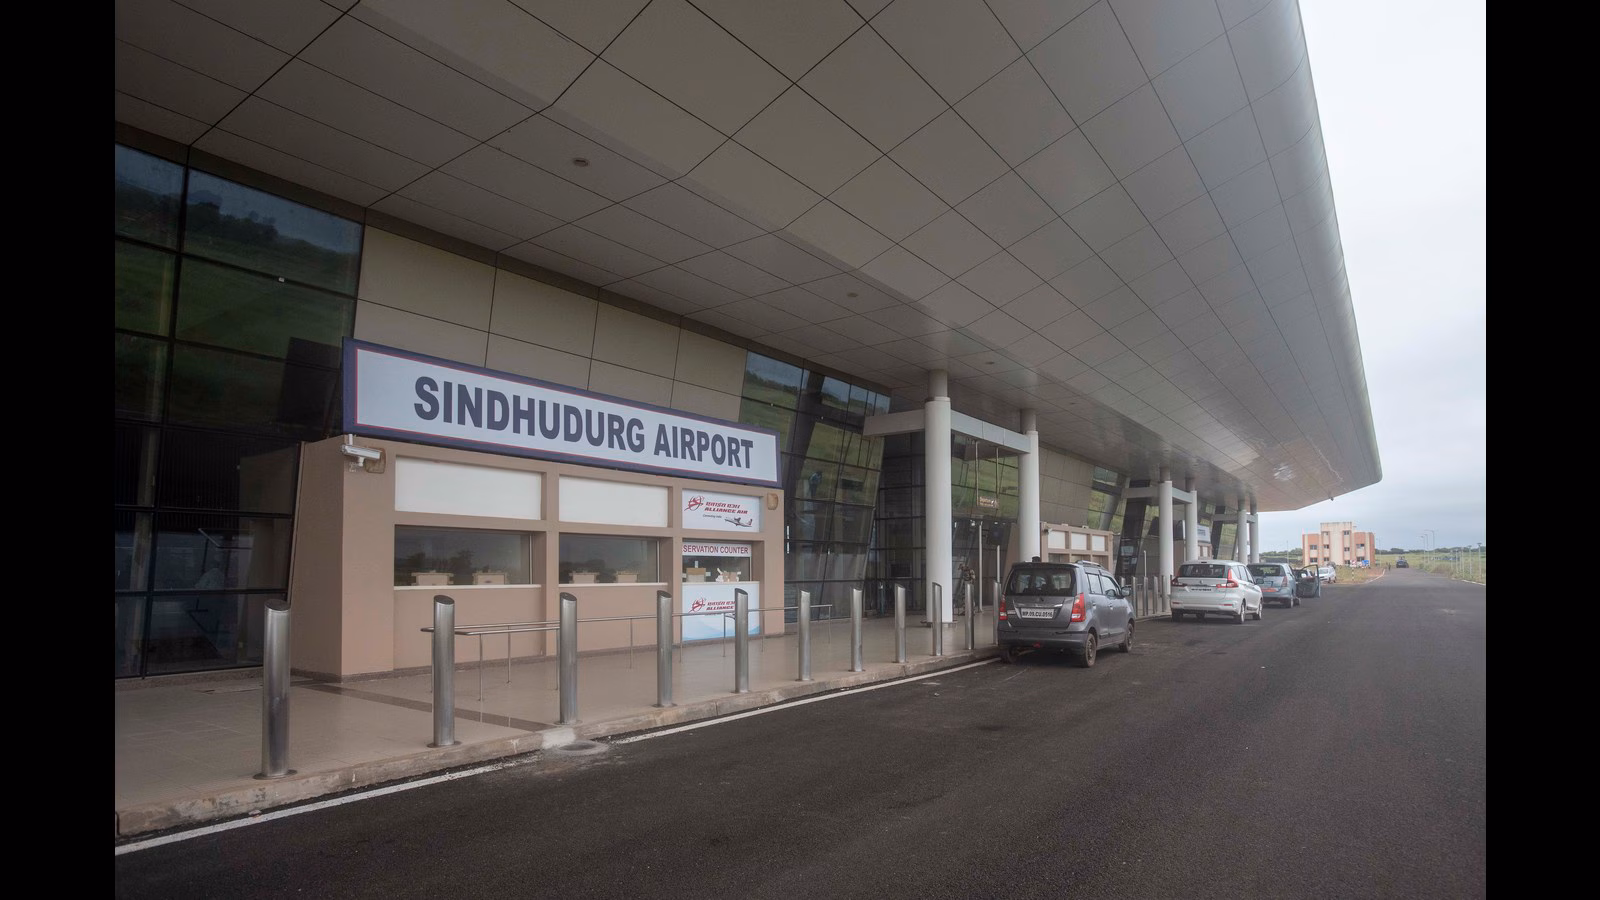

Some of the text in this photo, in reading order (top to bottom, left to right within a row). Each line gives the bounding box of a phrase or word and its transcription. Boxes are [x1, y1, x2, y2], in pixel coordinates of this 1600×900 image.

[414, 376, 754, 469] SINDHUDURG AIRPORT
[683, 544, 749, 554] SERVATION COUNTER
